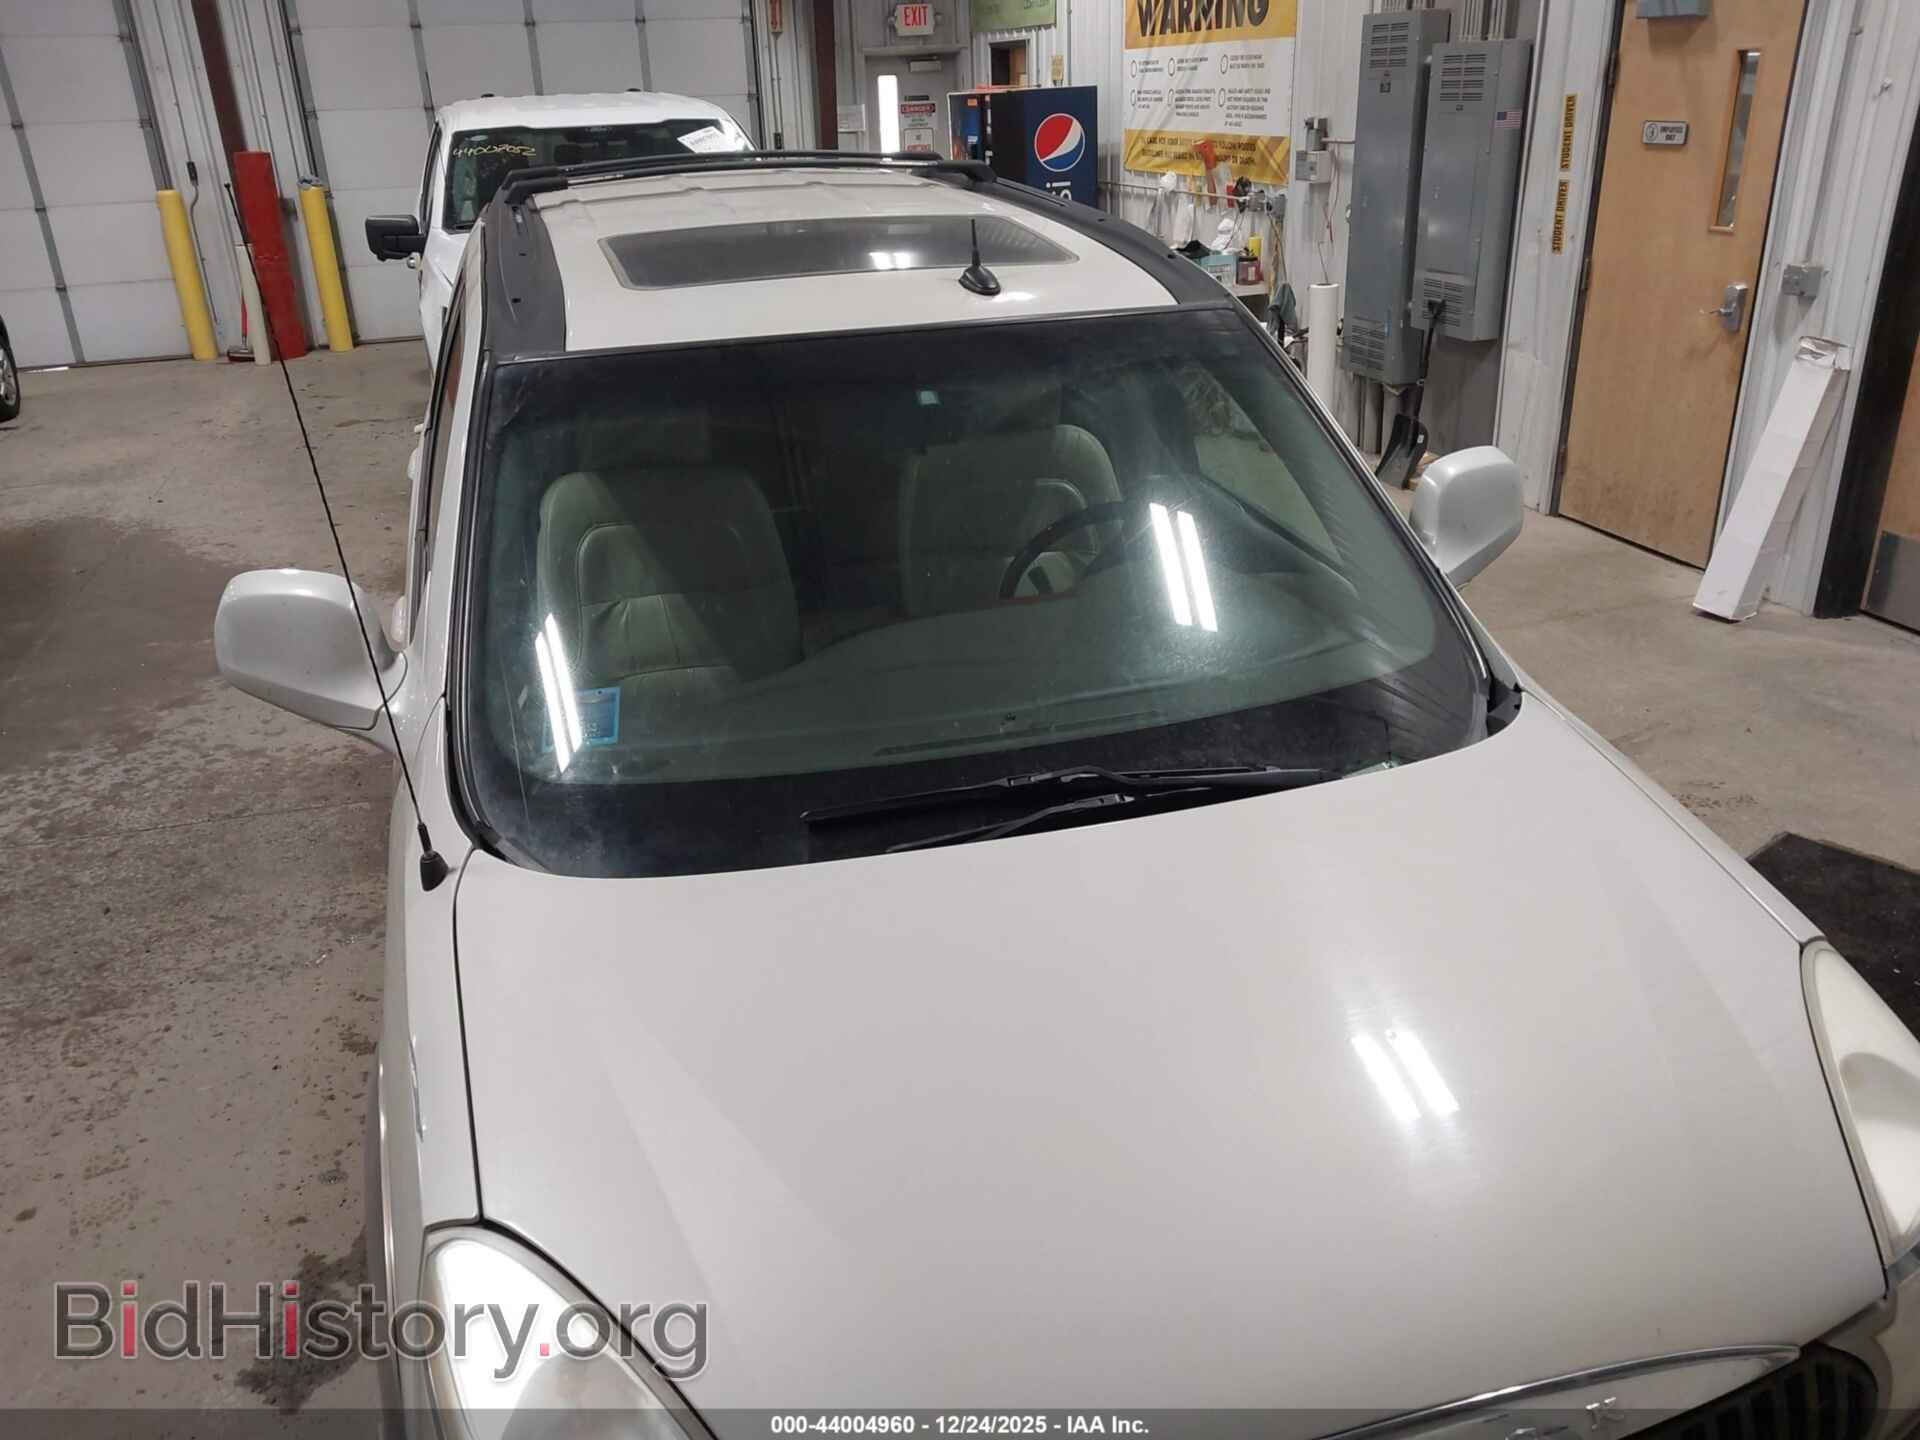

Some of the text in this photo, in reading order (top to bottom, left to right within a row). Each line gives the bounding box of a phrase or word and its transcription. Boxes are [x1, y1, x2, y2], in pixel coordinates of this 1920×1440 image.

[904, 5, 928, 26] EXIT
[1137, 0, 1270, 37] WARNING
[1561, 95, 1576, 169] STUDENT DRIVER
[1552, 180, 1568, 252] STUDENT DRIVER
